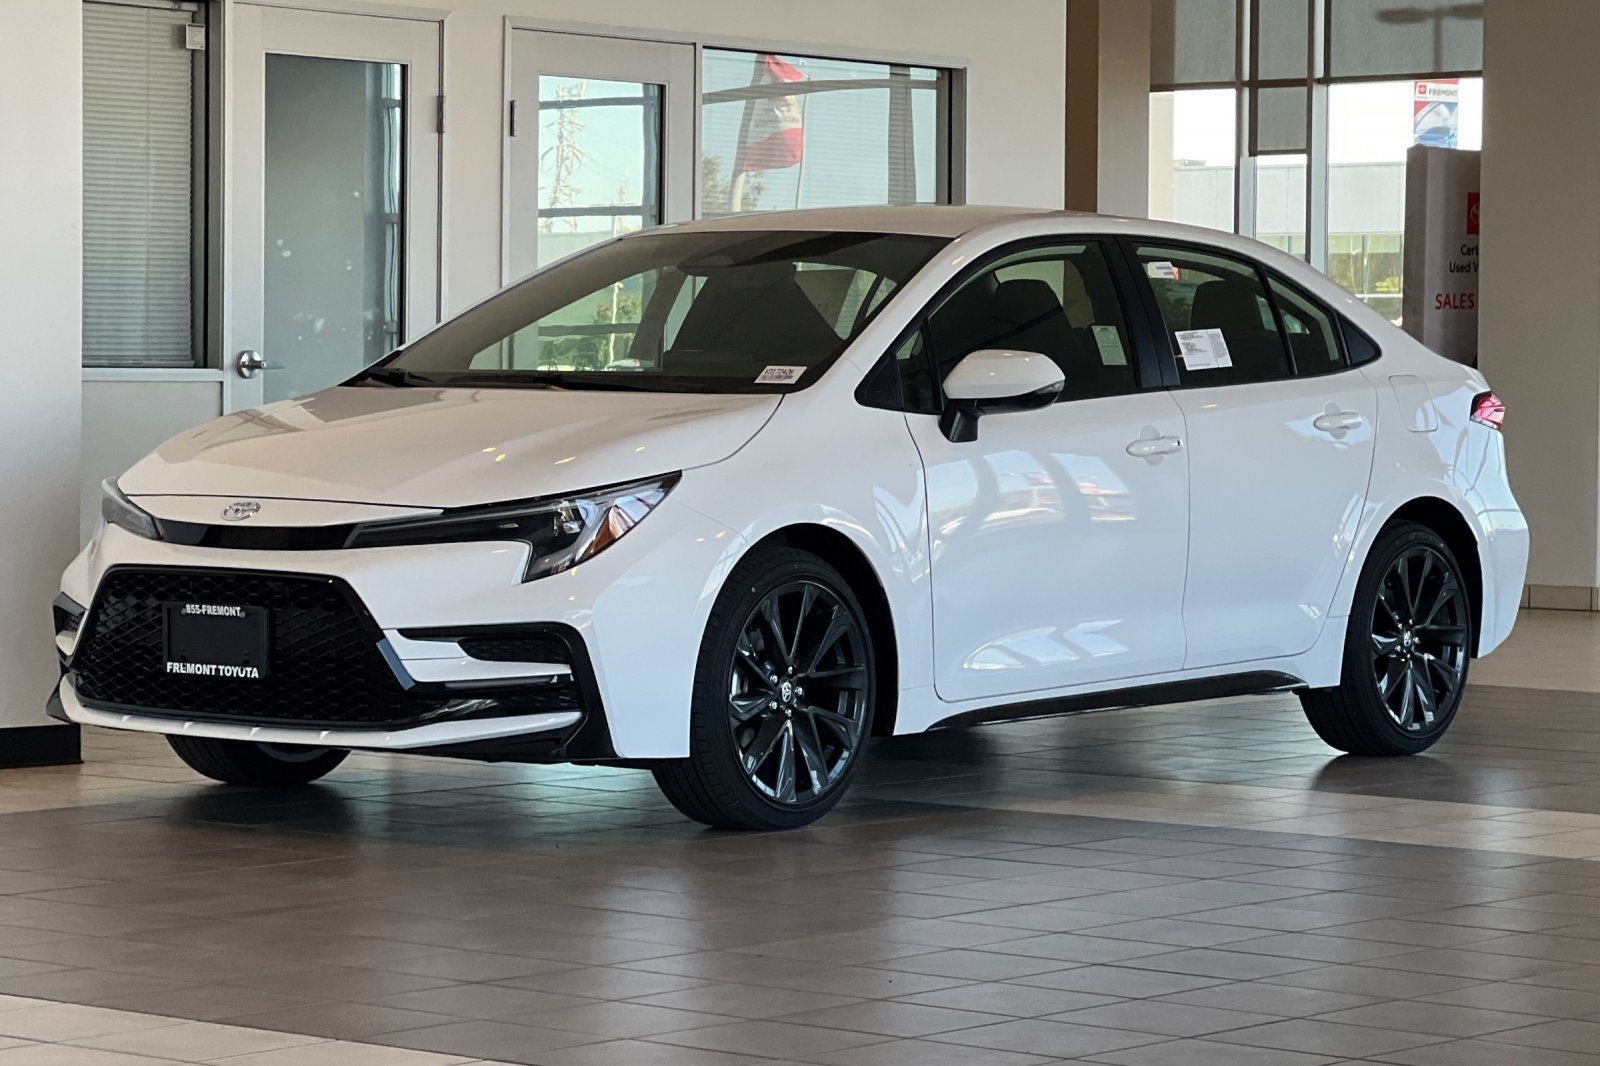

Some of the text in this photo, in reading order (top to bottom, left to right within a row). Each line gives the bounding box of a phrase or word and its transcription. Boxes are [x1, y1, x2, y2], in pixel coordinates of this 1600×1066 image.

[1429, 88, 1457, 96] FREMONT
[1449, 261, 1471, 273] Used
[1435, 293, 1475, 310] SALES
[186, 604, 240, 616] 855-FREMONT
[166, 662, 259, 678] FREMONT TOYOTA
